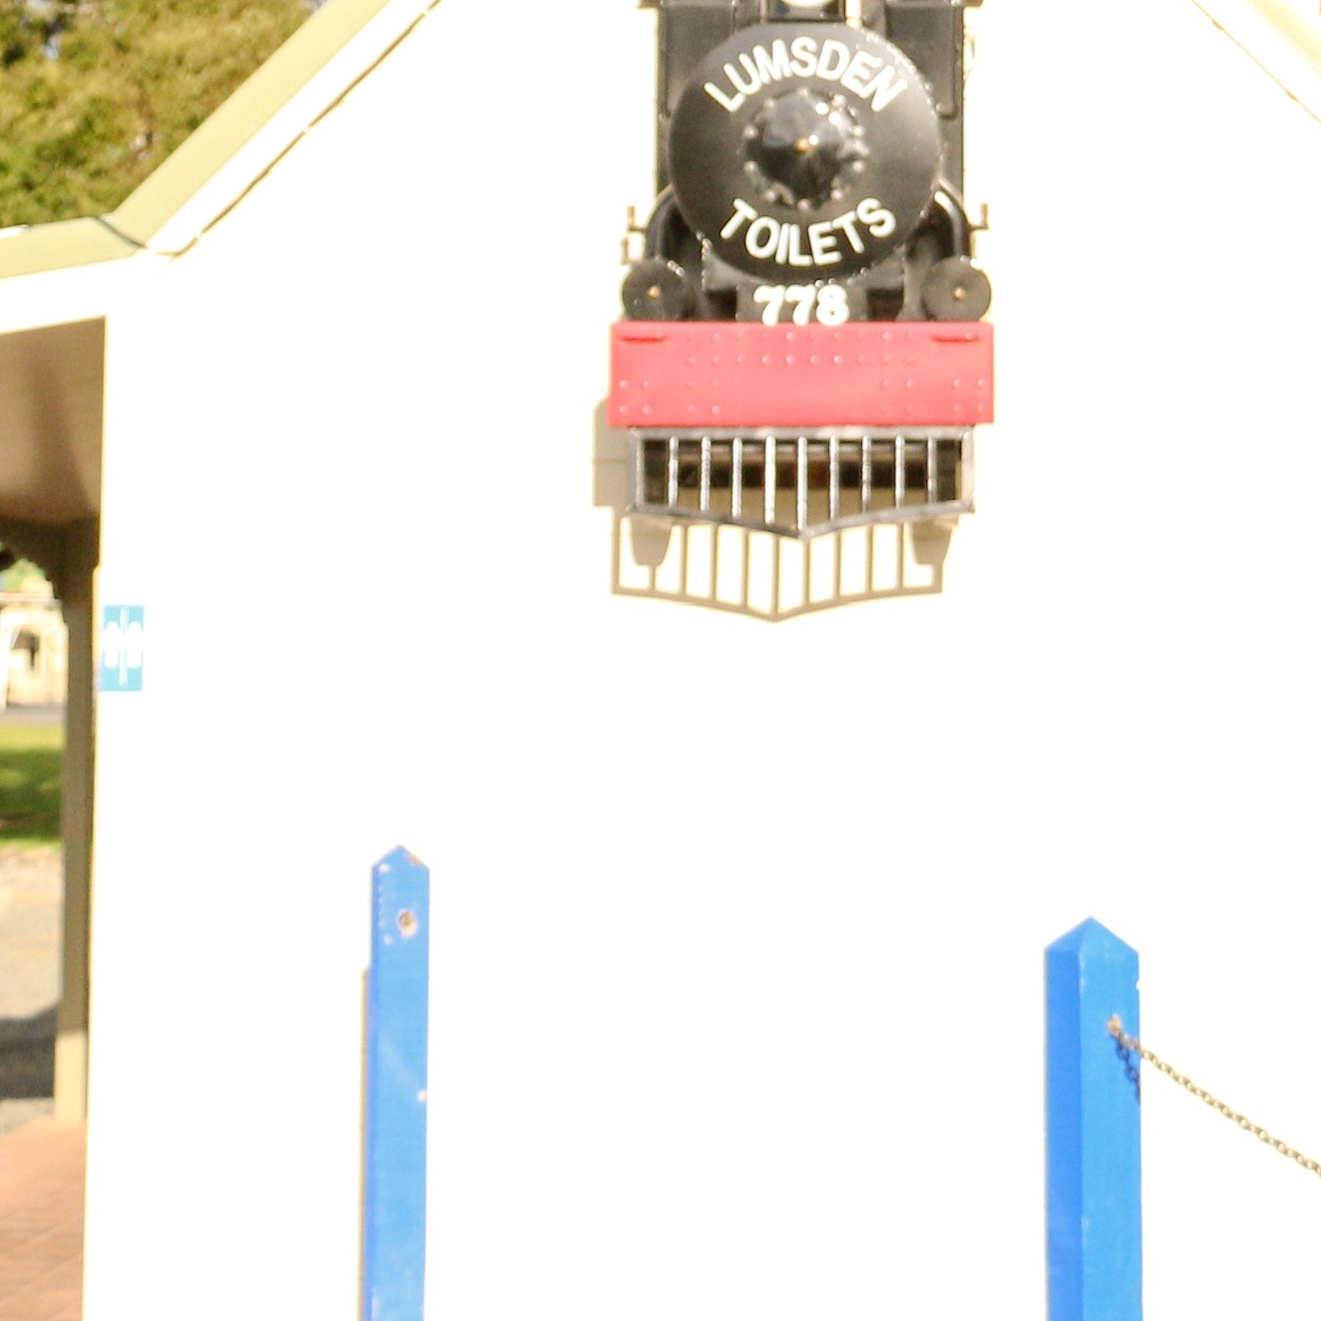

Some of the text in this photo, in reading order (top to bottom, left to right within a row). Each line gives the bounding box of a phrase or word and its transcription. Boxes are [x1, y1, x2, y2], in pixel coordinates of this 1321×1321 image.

[704, 36, 908, 112] LUMSDEN
[720, 196, 896, 266] TOILETS
[754, 284, 850, 326] 778
